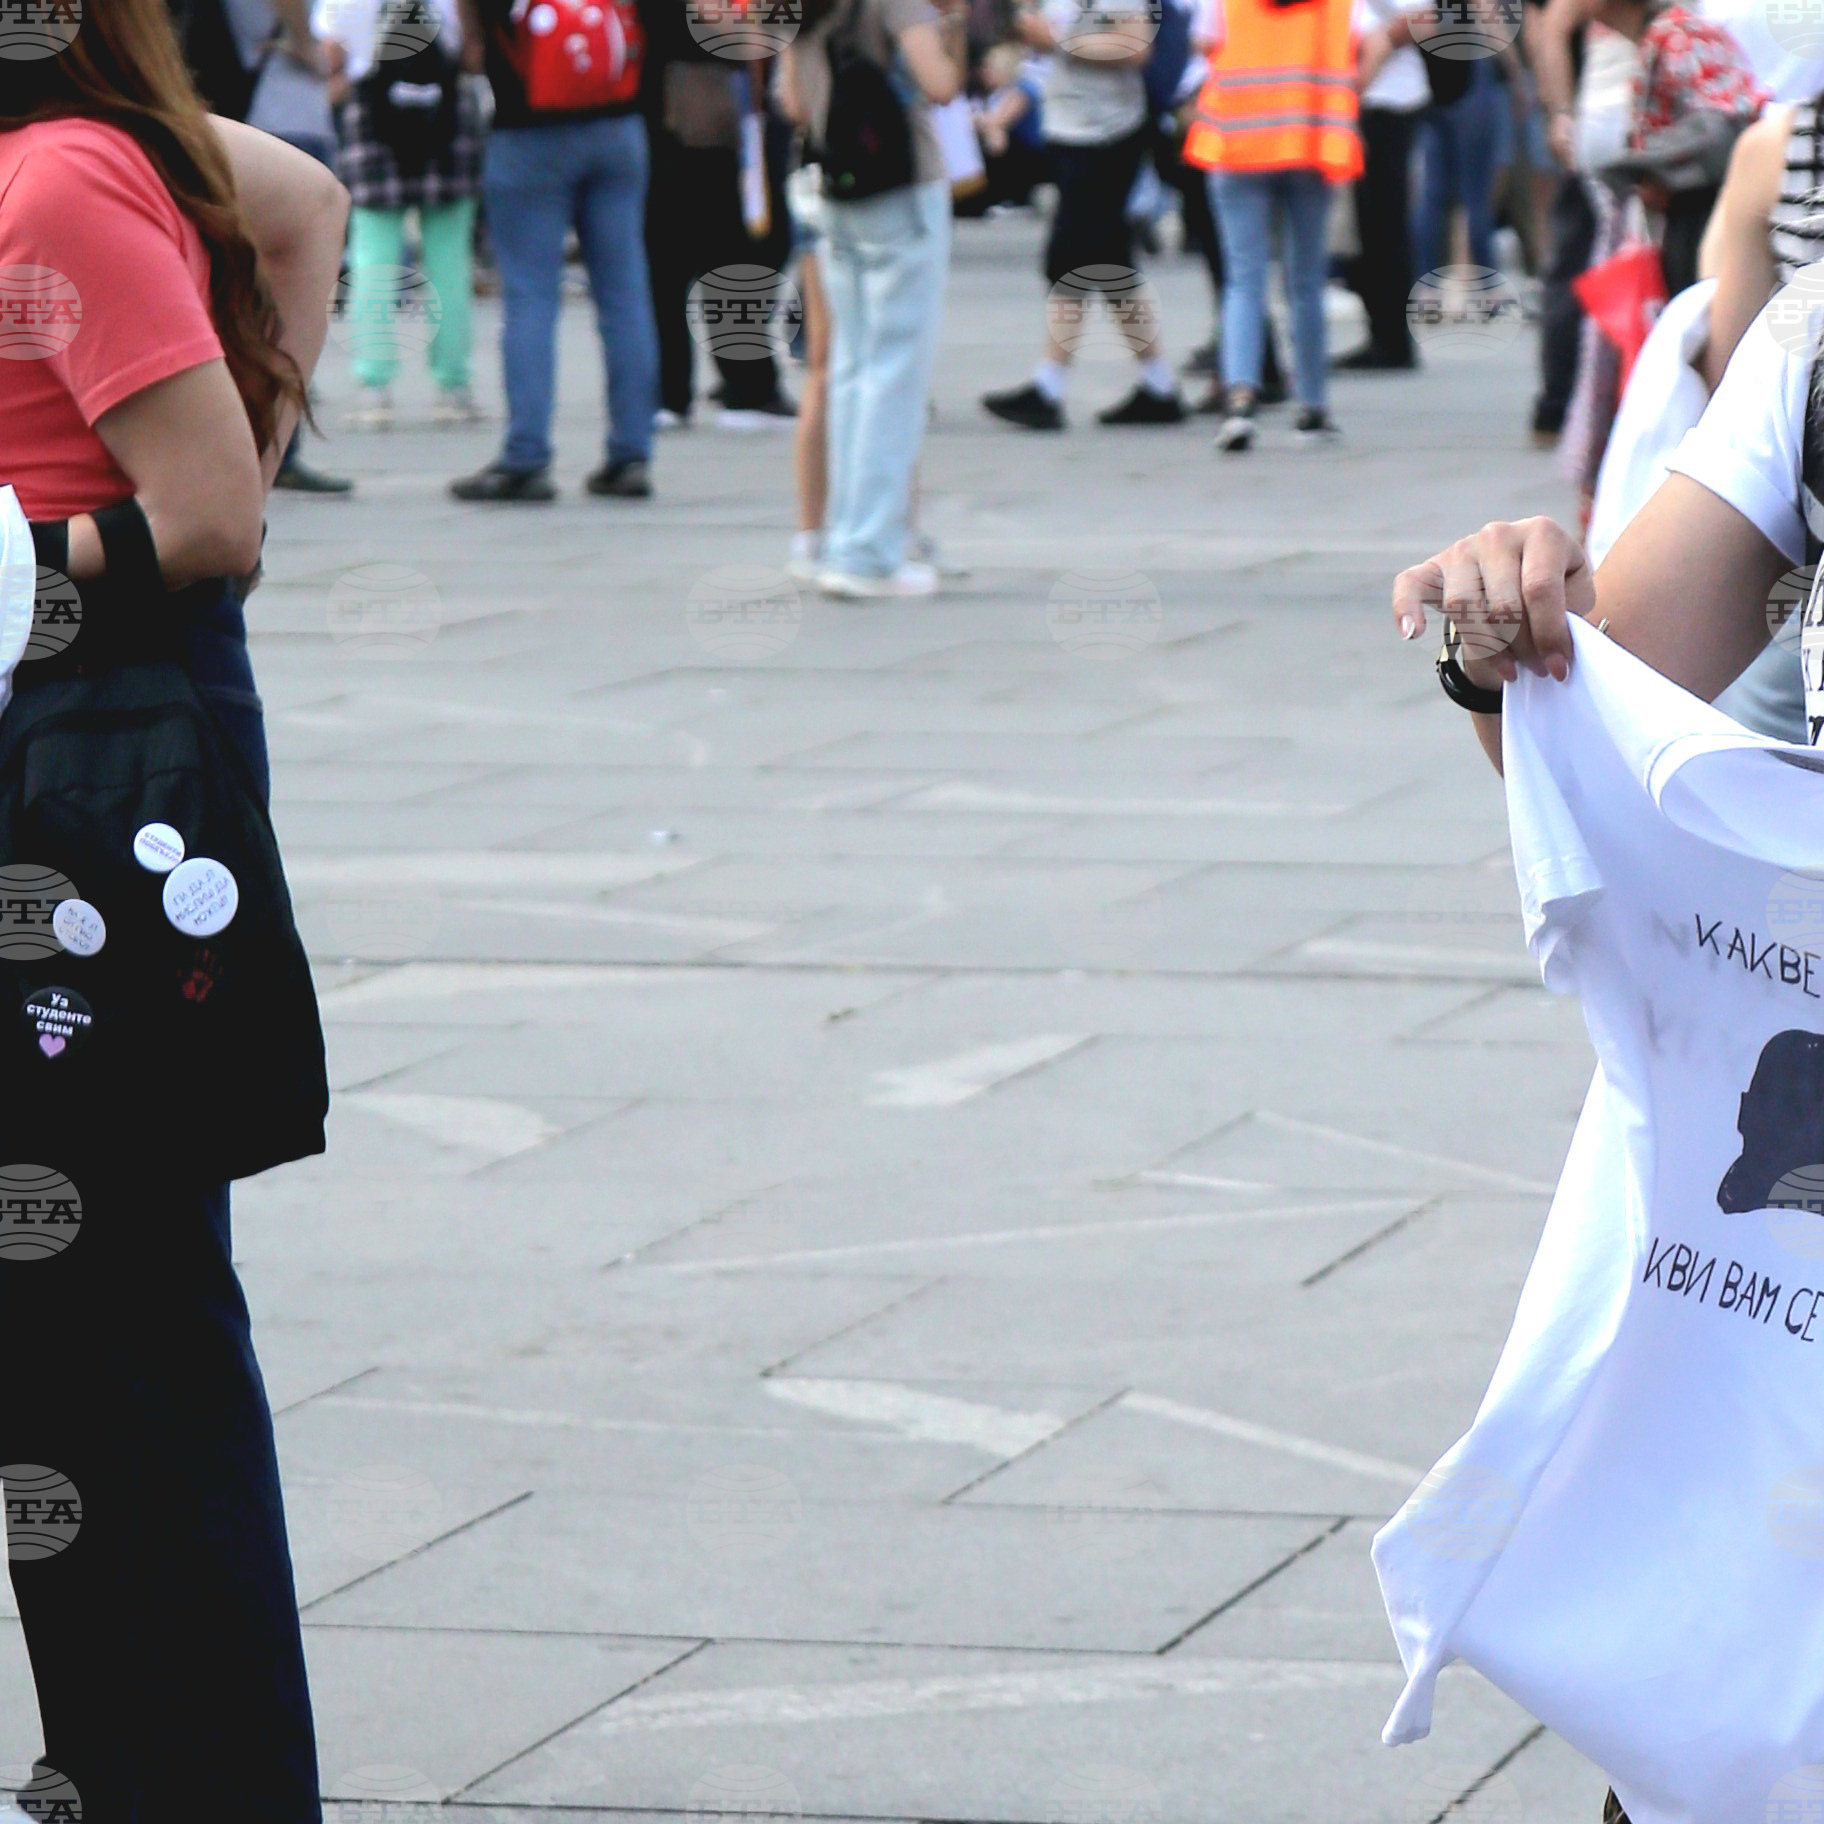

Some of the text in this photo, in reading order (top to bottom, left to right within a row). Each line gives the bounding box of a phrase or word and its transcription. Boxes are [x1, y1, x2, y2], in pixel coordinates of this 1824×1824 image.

[1695, 913, 1822, 998] КАКВЕ
[26, 1003, 92, 1026] студенте
[1643, 1237, 1717, 1303] КВИ
[1718, 1261, 1781, 1324] ВАМ
